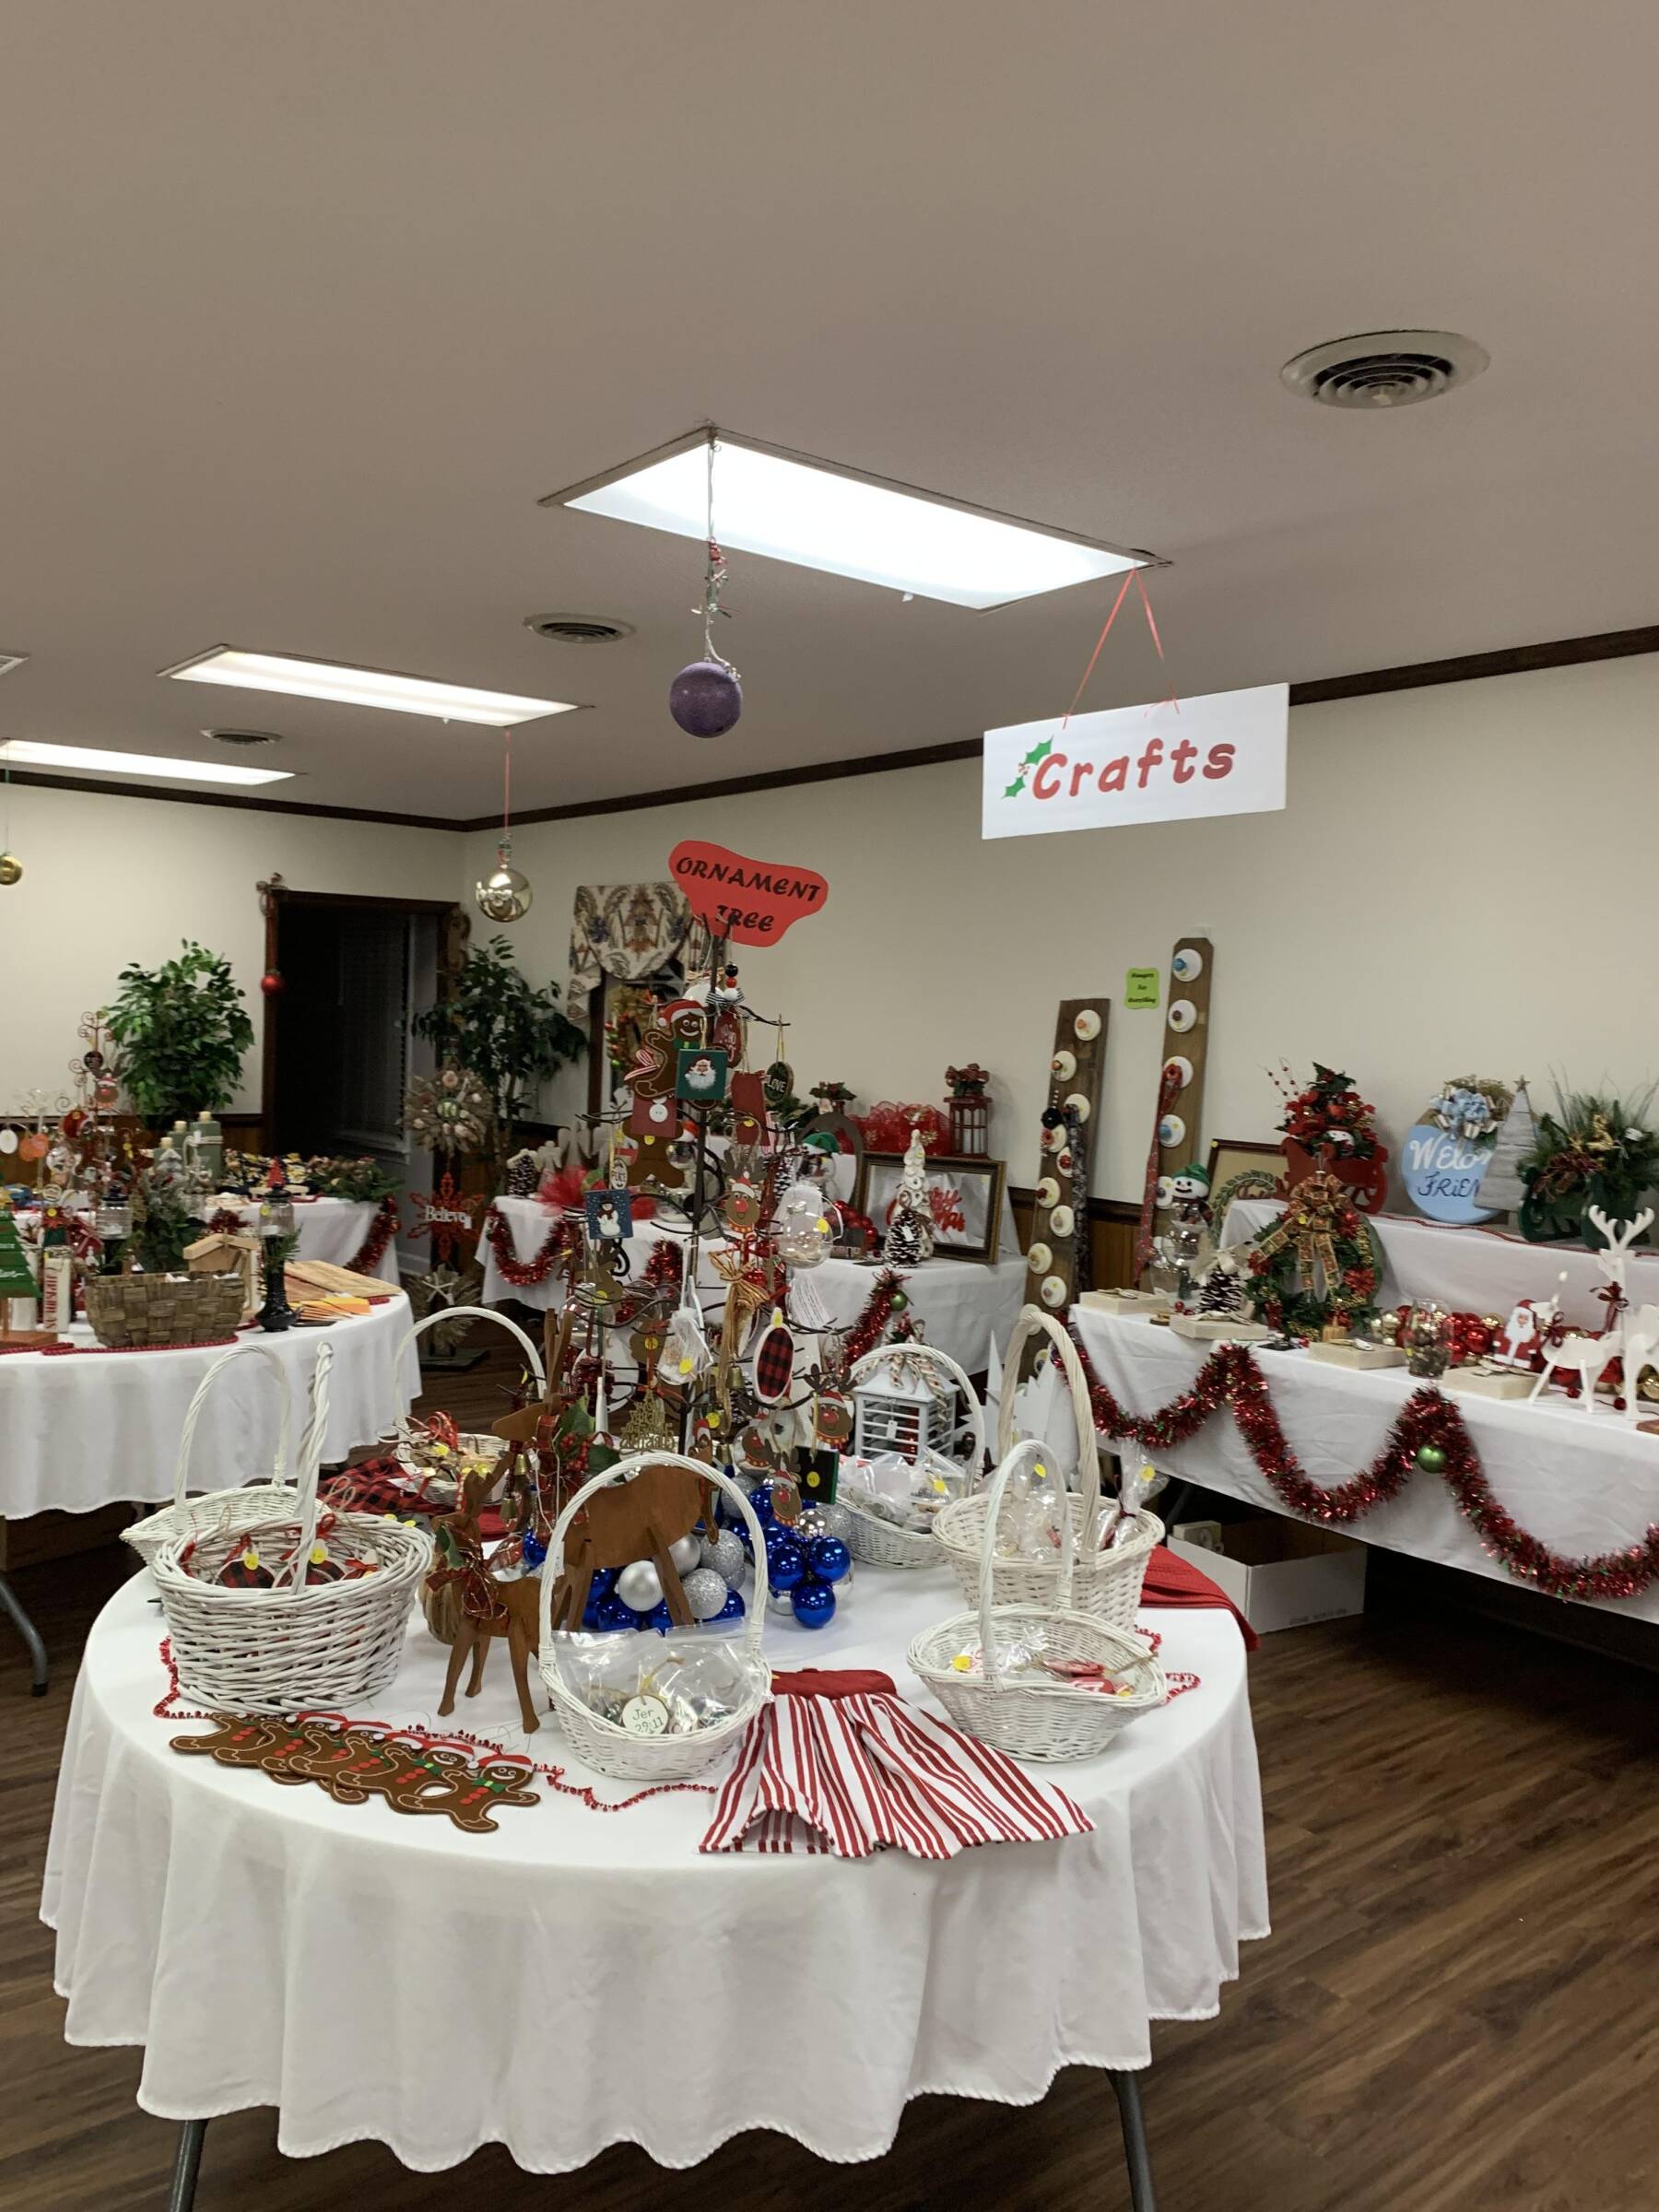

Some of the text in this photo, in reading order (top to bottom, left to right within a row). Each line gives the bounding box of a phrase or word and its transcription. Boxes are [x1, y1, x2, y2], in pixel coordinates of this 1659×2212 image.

[1032, 738, 1236, 800] Crafts
[677, 857, 820, 901] ORNAMENT
[716, 905, 774, 932] TREE
[632, 1708, 654, 1721] Jer
